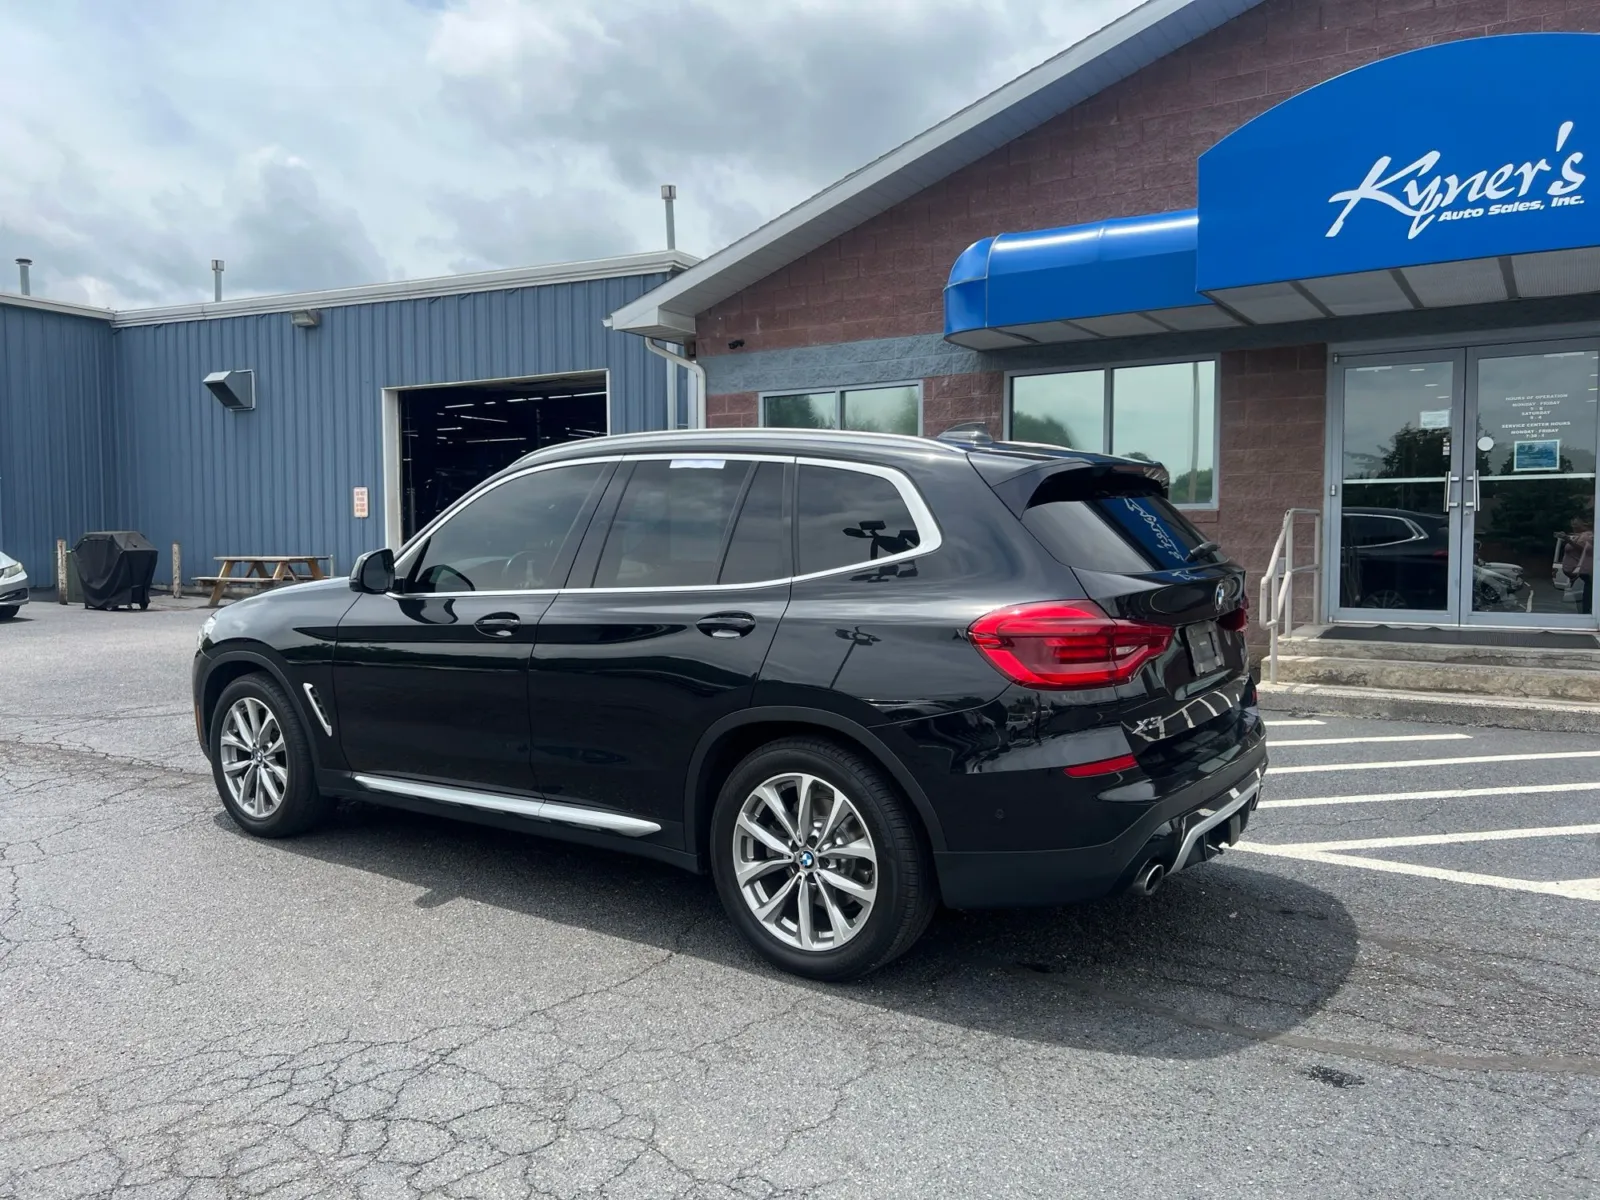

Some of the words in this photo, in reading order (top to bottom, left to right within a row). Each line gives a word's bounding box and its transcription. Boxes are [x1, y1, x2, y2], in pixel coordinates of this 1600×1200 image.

[1325, 120, 1586, 240] Kyner's
[1438, 206, 1484, 222] Auto
[1488, 200, 1545, 216] Sales,
[1551, 194, 1585, 208] Inc.
[1132, 715, 1162, 735] X3
